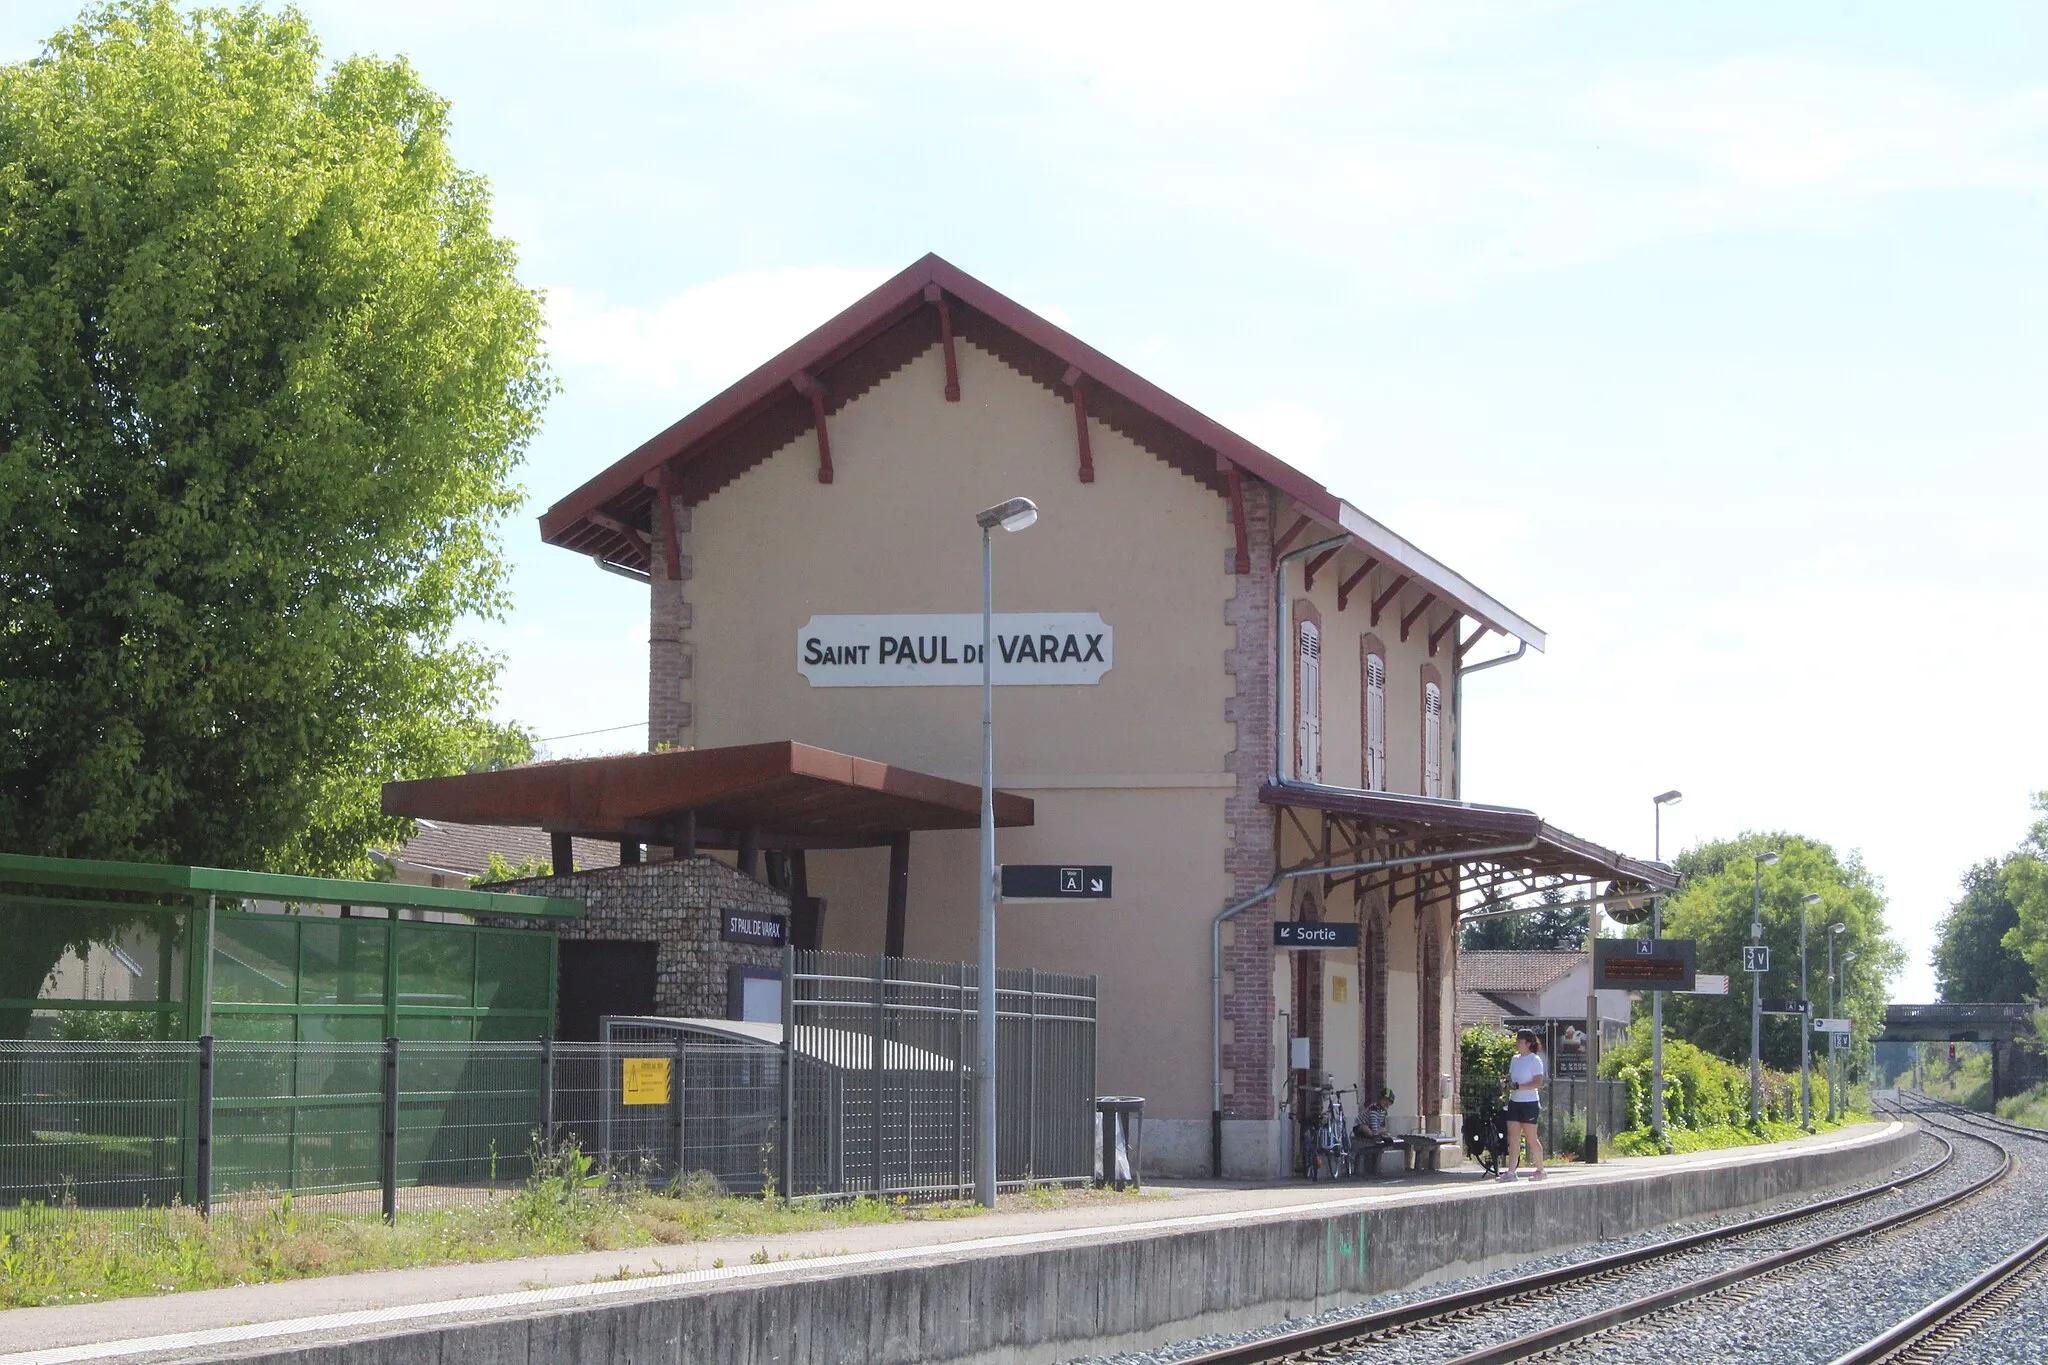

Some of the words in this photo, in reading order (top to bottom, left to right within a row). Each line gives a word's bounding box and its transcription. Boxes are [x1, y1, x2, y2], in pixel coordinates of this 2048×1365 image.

[879, 635, 957, 664] PAUL
[997, 633, 1104, 663] VARAX
[1067, 877, 1077, 888] A
[730, 917, 737, 932] ST
[737, 918, 752, 935] PAUL
[752, 920, 761, 936] DE
[761, 921, 780, 938] VARAX
[1297, 927, 1336, 940] Sortie
[1747, 948, 1755, 959] 3
[1747, 959, 1755, 970] 4
